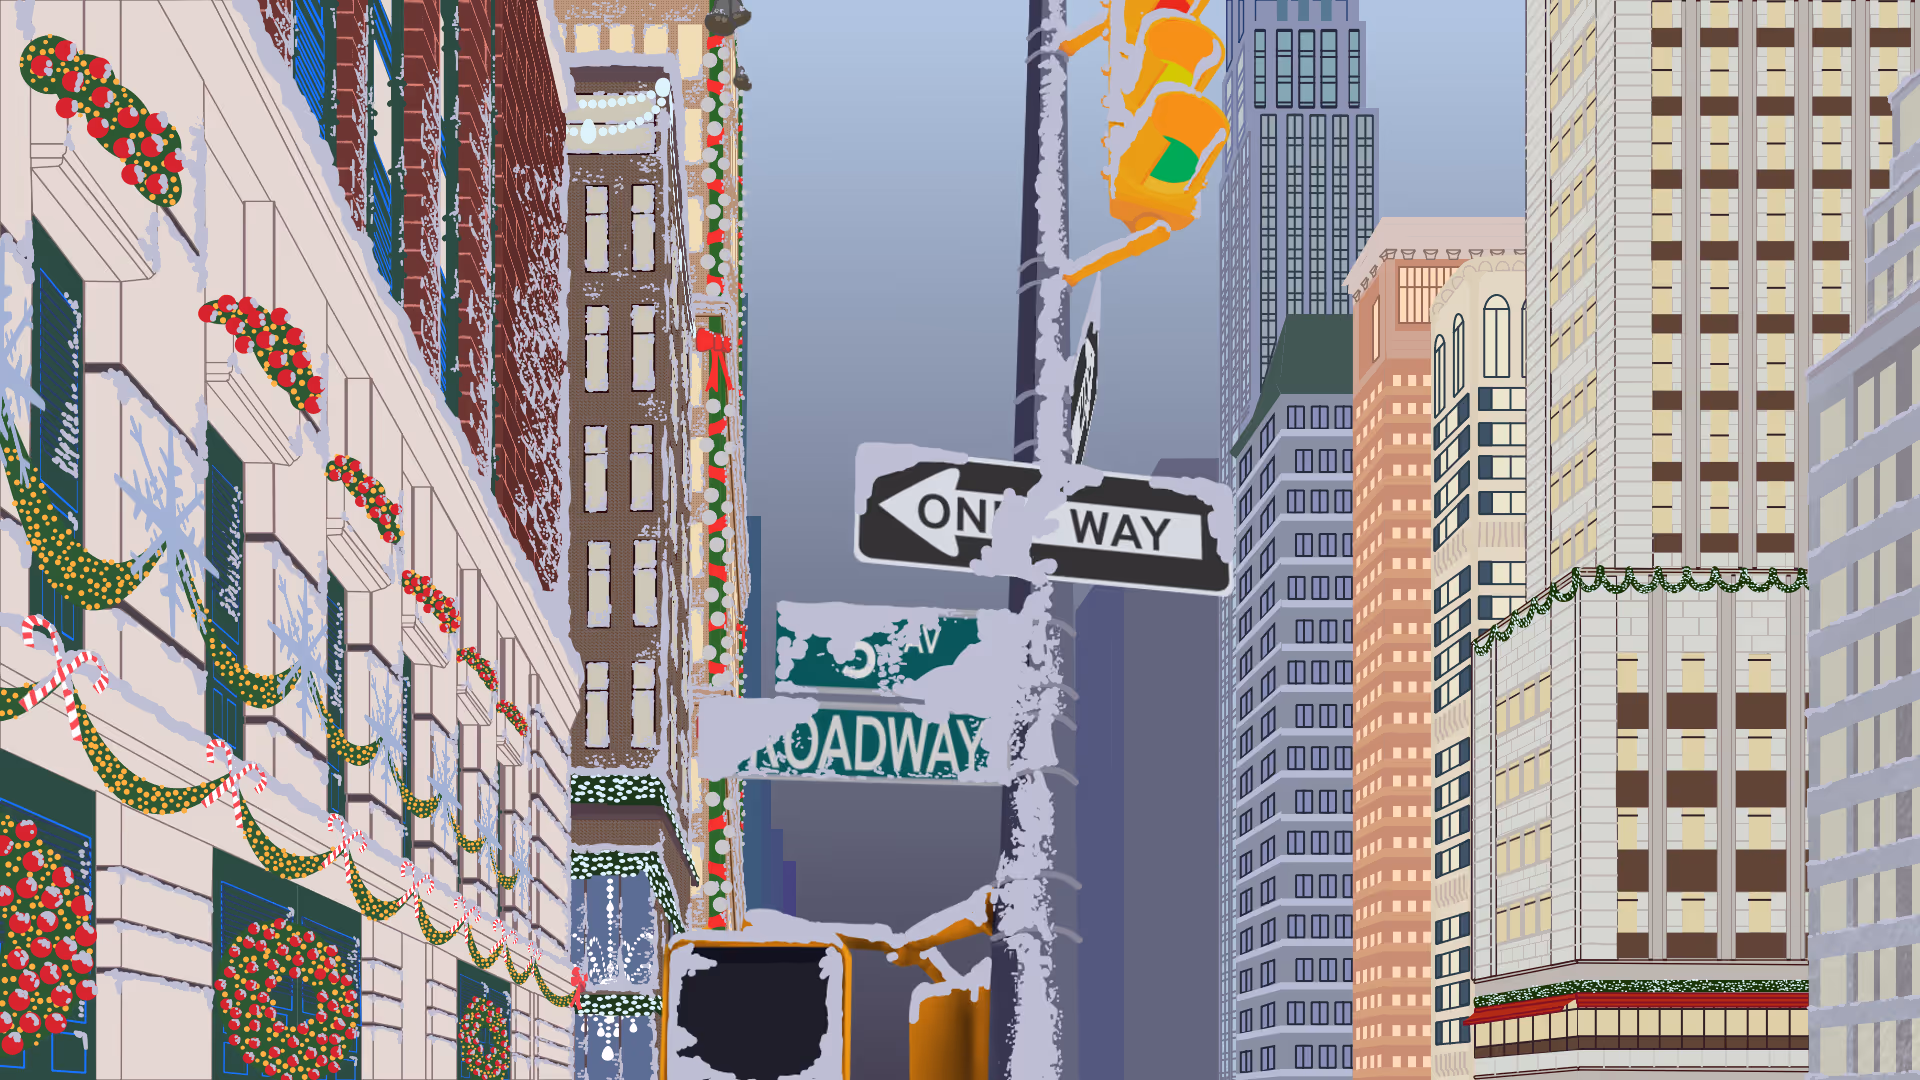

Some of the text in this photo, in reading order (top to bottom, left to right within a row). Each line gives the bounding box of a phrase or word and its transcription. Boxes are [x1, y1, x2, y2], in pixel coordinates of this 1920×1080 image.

[918, 493, 1171, 551] ON WAY
[747, 714, 985, 773] OADWAY
